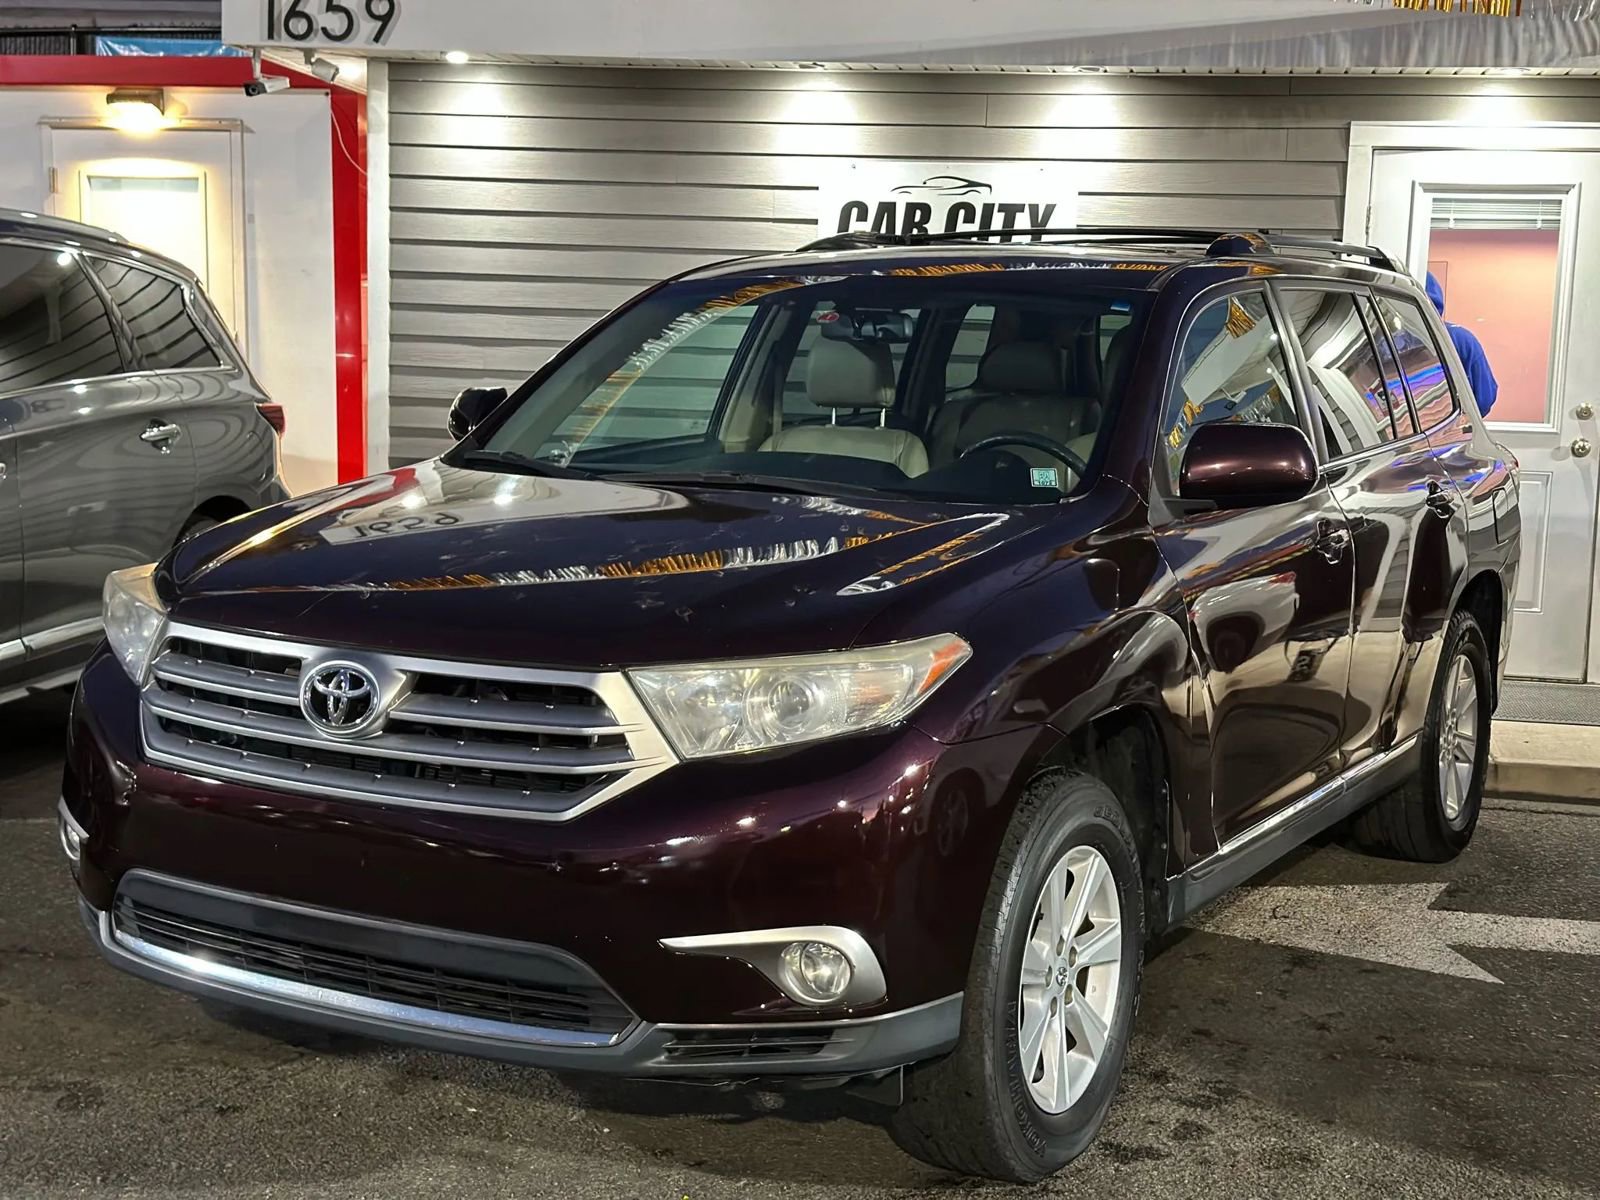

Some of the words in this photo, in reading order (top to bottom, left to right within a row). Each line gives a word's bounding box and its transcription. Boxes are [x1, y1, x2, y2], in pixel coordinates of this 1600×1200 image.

[267, 0, 395, 43] 1659
[837, 201, 931, 235] CAR
[945, 202, 1057, 242] CITY
